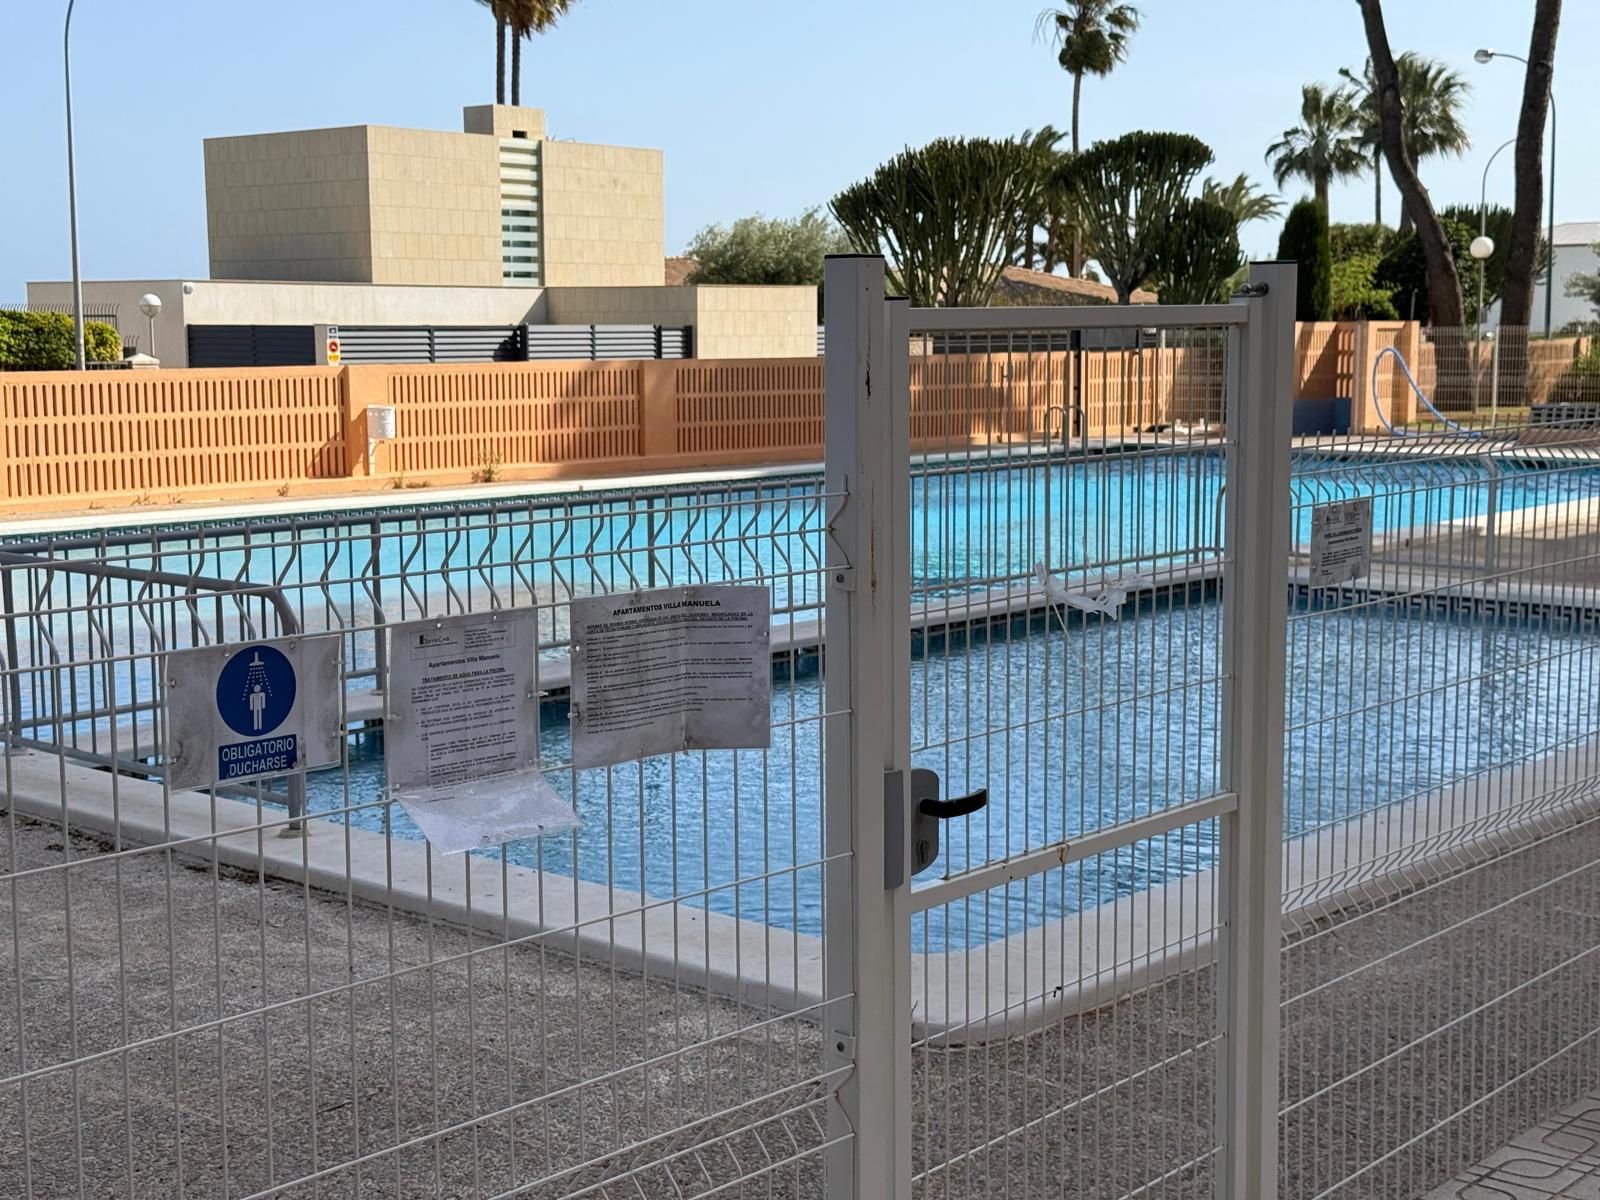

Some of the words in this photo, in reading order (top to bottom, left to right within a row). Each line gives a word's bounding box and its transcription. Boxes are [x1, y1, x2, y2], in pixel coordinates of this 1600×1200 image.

[612, 604, 663, 616] APARTAMENTOS
[663, 602, 681, 610] VILLA
[681, 600, 721, 608] MANUELA
[428, 659, 466, 669] Apartamentos
[479, 654, 500, 662] Manuela
[222, 737, 294, 761] OBLIGATORIO
[229, 755, 288, 776] DUCHARSE
